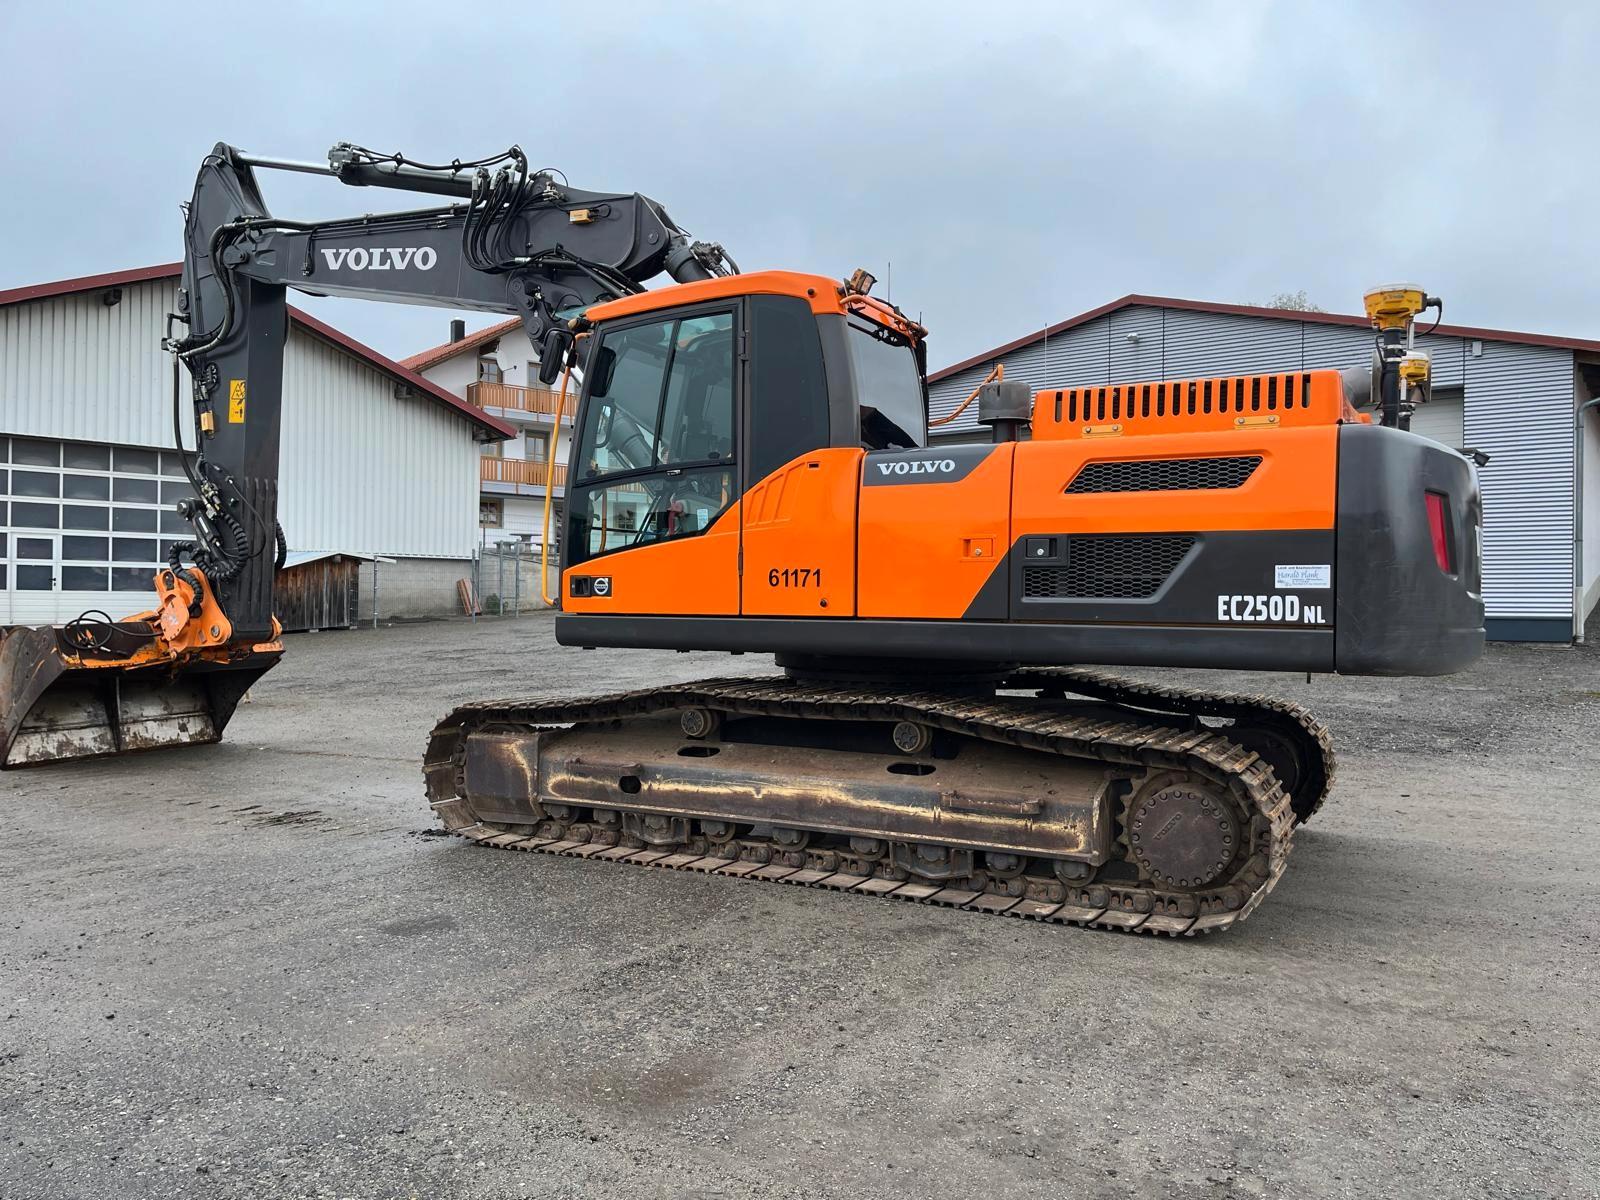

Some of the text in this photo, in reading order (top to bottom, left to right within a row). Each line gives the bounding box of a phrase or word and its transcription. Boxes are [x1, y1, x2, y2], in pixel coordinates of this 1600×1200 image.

[320, 246, 438, 271] VOLVO
[876, 459, 956, 475] VOLVO
[768, 568, 822, 588] 61171
[1217, 595, 1326, 624] EC250D NL
